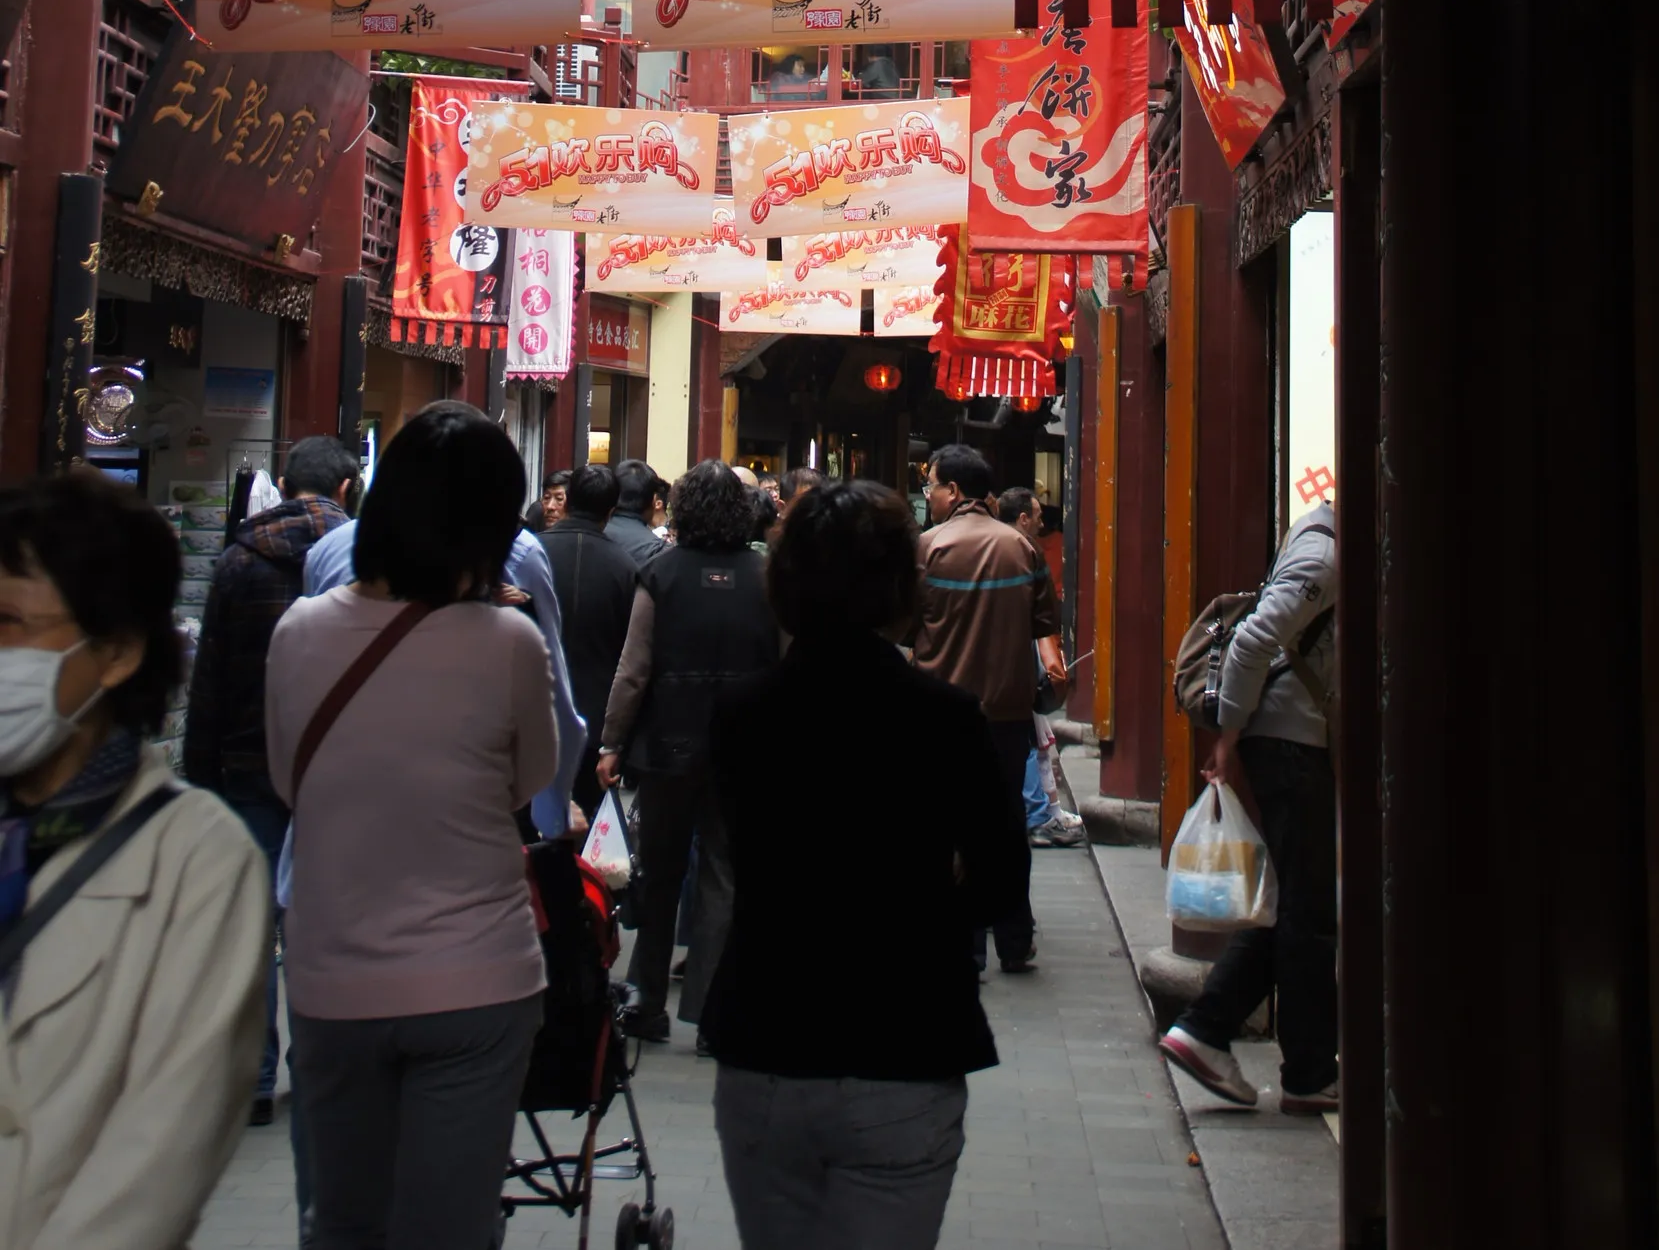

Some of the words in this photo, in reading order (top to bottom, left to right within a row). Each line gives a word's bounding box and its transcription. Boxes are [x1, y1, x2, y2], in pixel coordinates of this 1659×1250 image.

[490, 127, 689, 203] 51欢乐购
[757, 118, 954, 214] 51欢乐购
[969, 304, 1031, 330] 麻花
